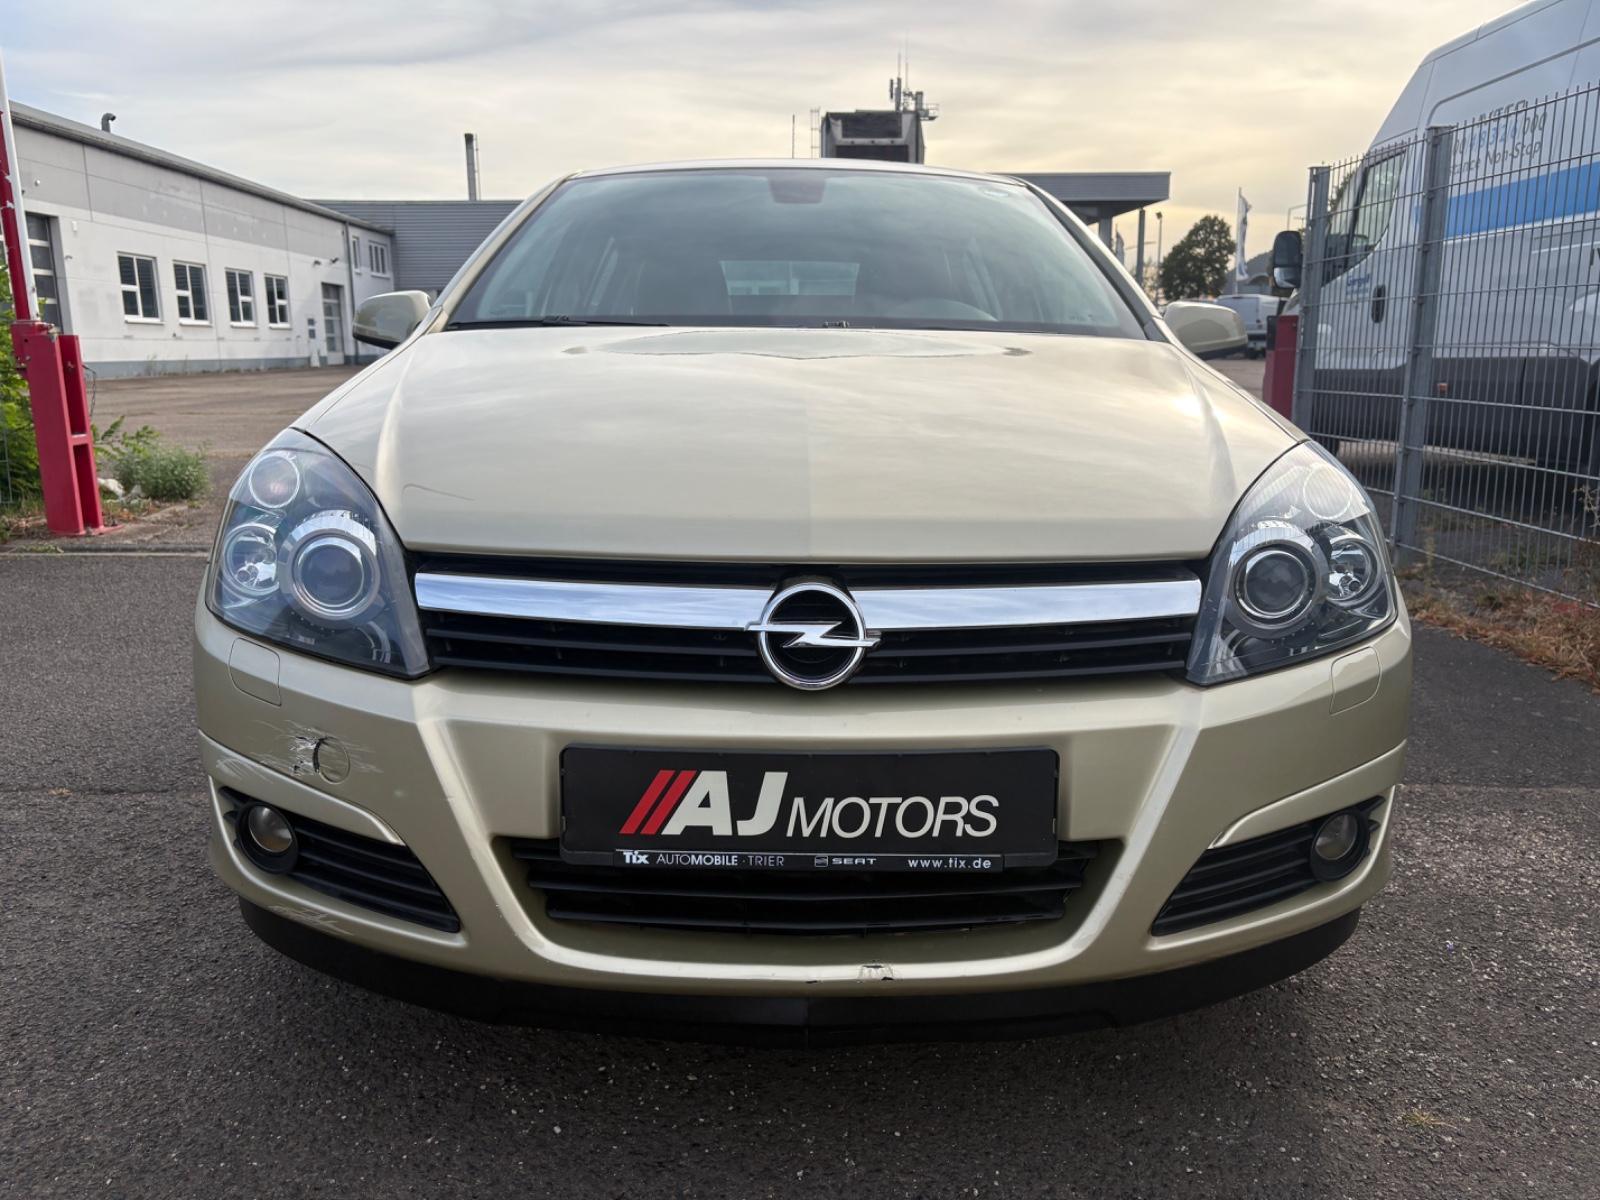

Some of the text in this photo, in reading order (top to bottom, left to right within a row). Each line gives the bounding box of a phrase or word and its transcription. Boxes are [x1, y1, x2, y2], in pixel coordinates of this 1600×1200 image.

[661, 770, 999, 839] AJ MOTORS
[623, 850, 650, 865] Tix
[656, 853, 738, 866] AUTOMOBILE
[748, 855, 785, 867] TRIER
[832, 857, 877, 865] SEAT
